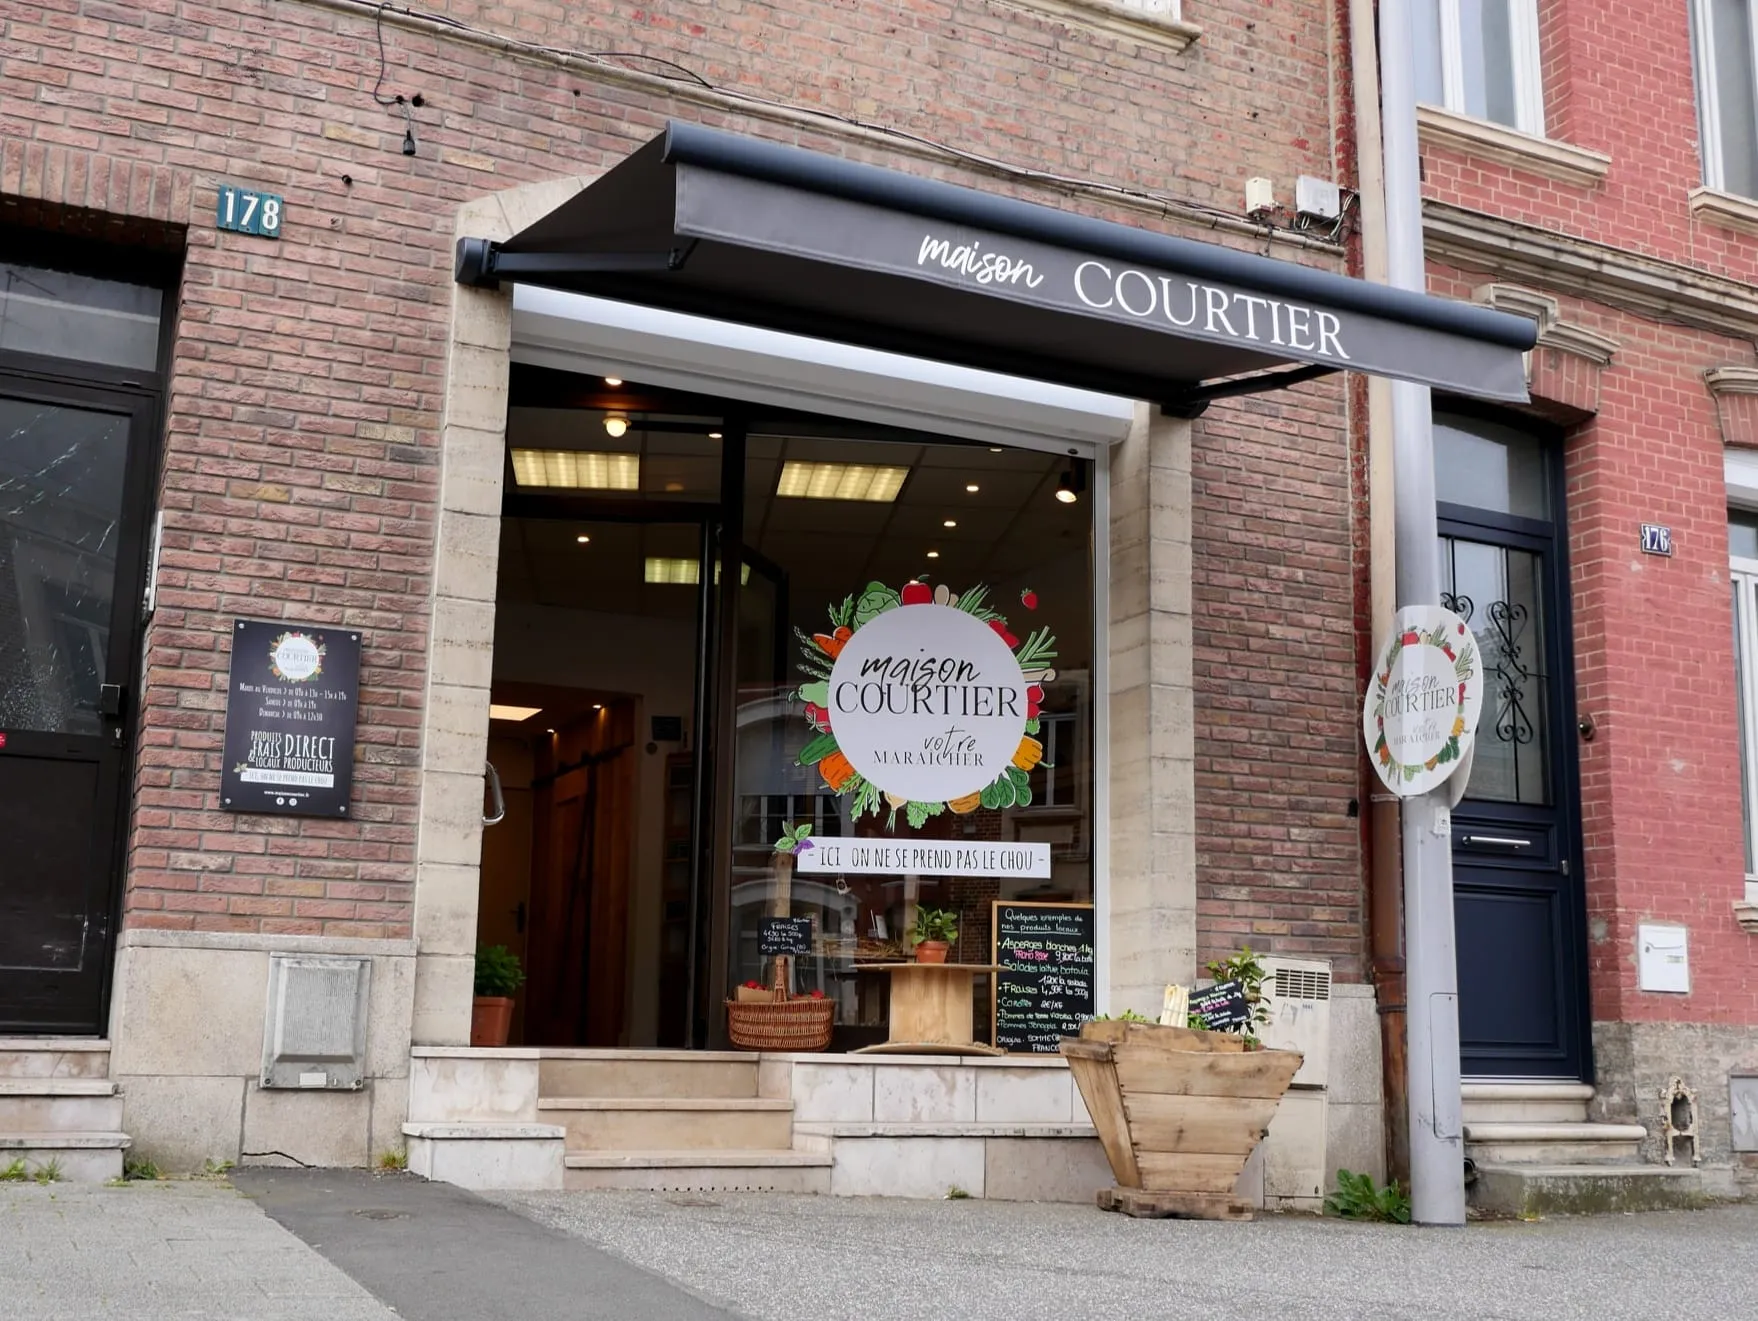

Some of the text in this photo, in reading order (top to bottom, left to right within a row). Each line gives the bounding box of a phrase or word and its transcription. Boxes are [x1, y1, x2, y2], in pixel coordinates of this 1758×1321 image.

[225, 192, 279, 230] 178
[918, 235, 1350, 359] maison COURTIER
[1645, 526, 1668, 552] 176
[860, 648, 981, 694] maison
[1392, 671, 1440, 697] maison
[835, 681, 1020, 718] COURTIER
[1385, 686, 1455, 719] COURTIER
[250, 730, 282, 743] PRODUITS
[253, 740, 281, 758] FRAIS
[284, 733, 335, 760] DIRECT
[924, 725, 976, 758] votre
[248, 749, 281, 768] & LOCAUX
[283, 756, 333, 773] PRODUCTEURS
[820, 846, 1033, 870] ICI ON NE SE PREND PAS LE CHOU
[1005, 908, 1038, 923] Quelques
[1020, 923, 1051, 935] produits
